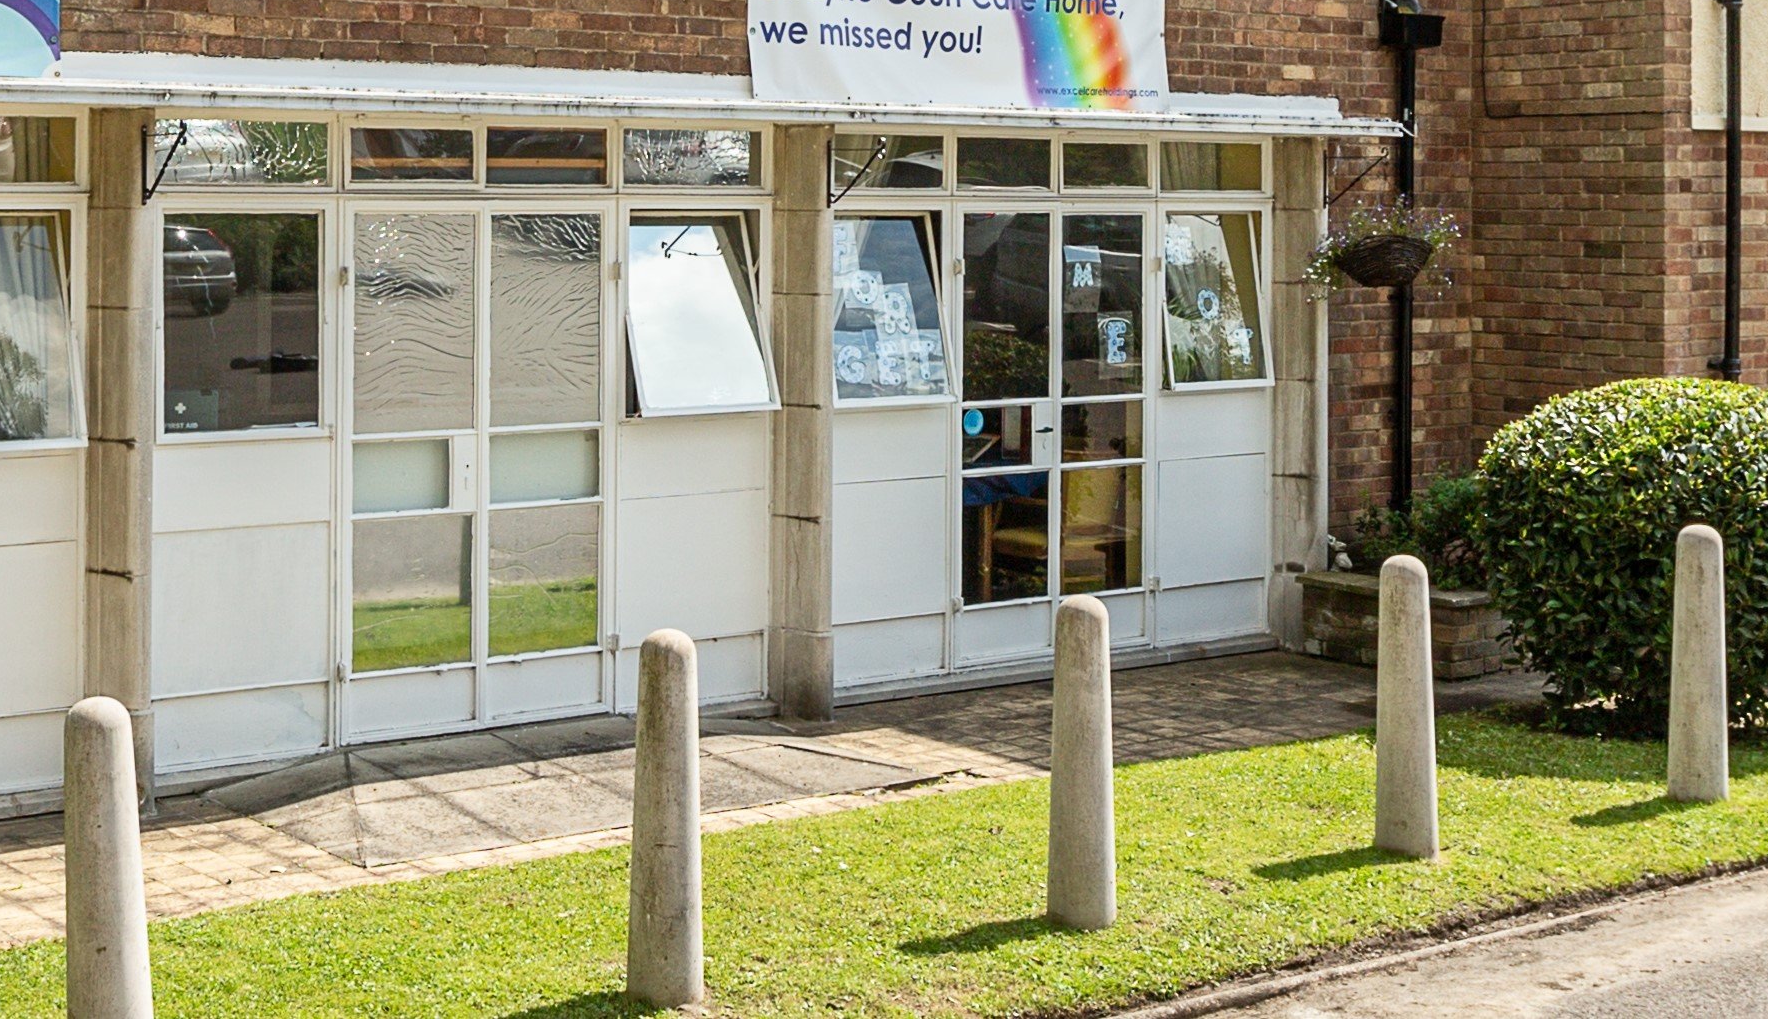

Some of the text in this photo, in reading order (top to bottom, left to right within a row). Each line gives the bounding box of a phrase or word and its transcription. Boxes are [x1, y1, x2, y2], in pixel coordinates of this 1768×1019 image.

[760, 17, 982, 58] we missed you!
[1038, 86, 1159, 98] www.excelcareholdings.com
[185, 421, 199, 429] AID
